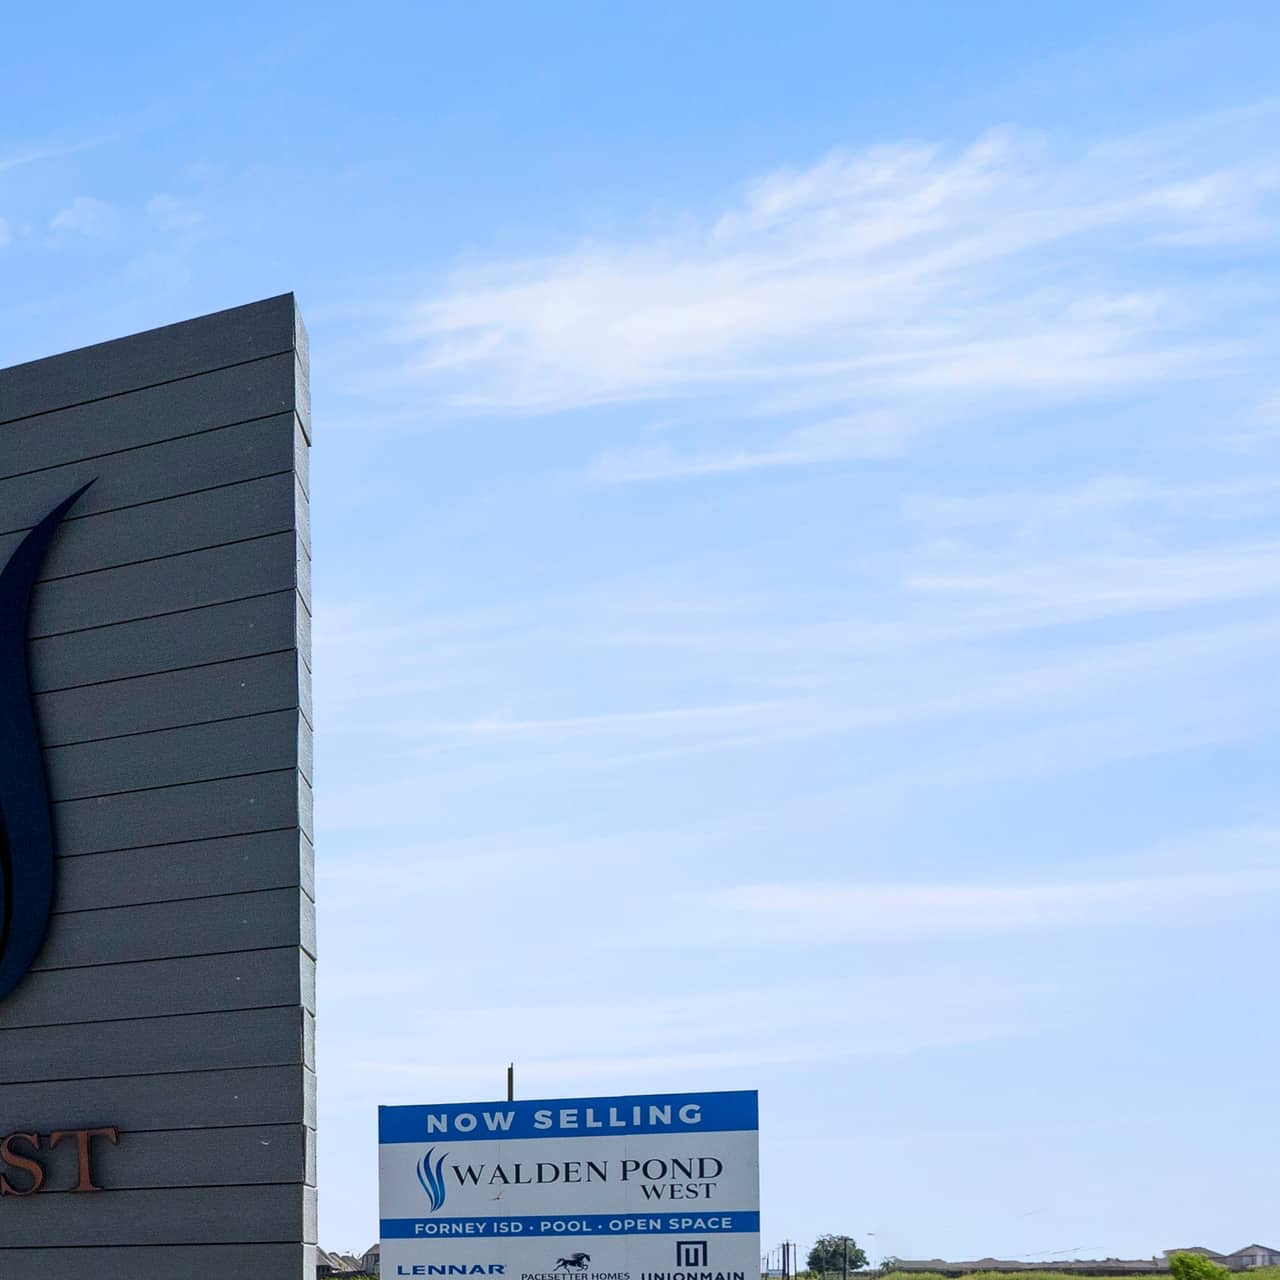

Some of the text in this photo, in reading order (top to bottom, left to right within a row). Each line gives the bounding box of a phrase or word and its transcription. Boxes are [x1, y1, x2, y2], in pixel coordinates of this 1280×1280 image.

[427, 1104, 702, 1133] NOW SELLING
[450, 1157, 723, 1186] WALDEN POND
[640, 1182, 717, 1200] WEST
[415, 1217, 732, 1234] FORNEY ISD POOL OPEN SPACE
[397, 1264, 506, 1276] LENNAR
[521, 1272, 631, 1280] PACESETTER HOMES
